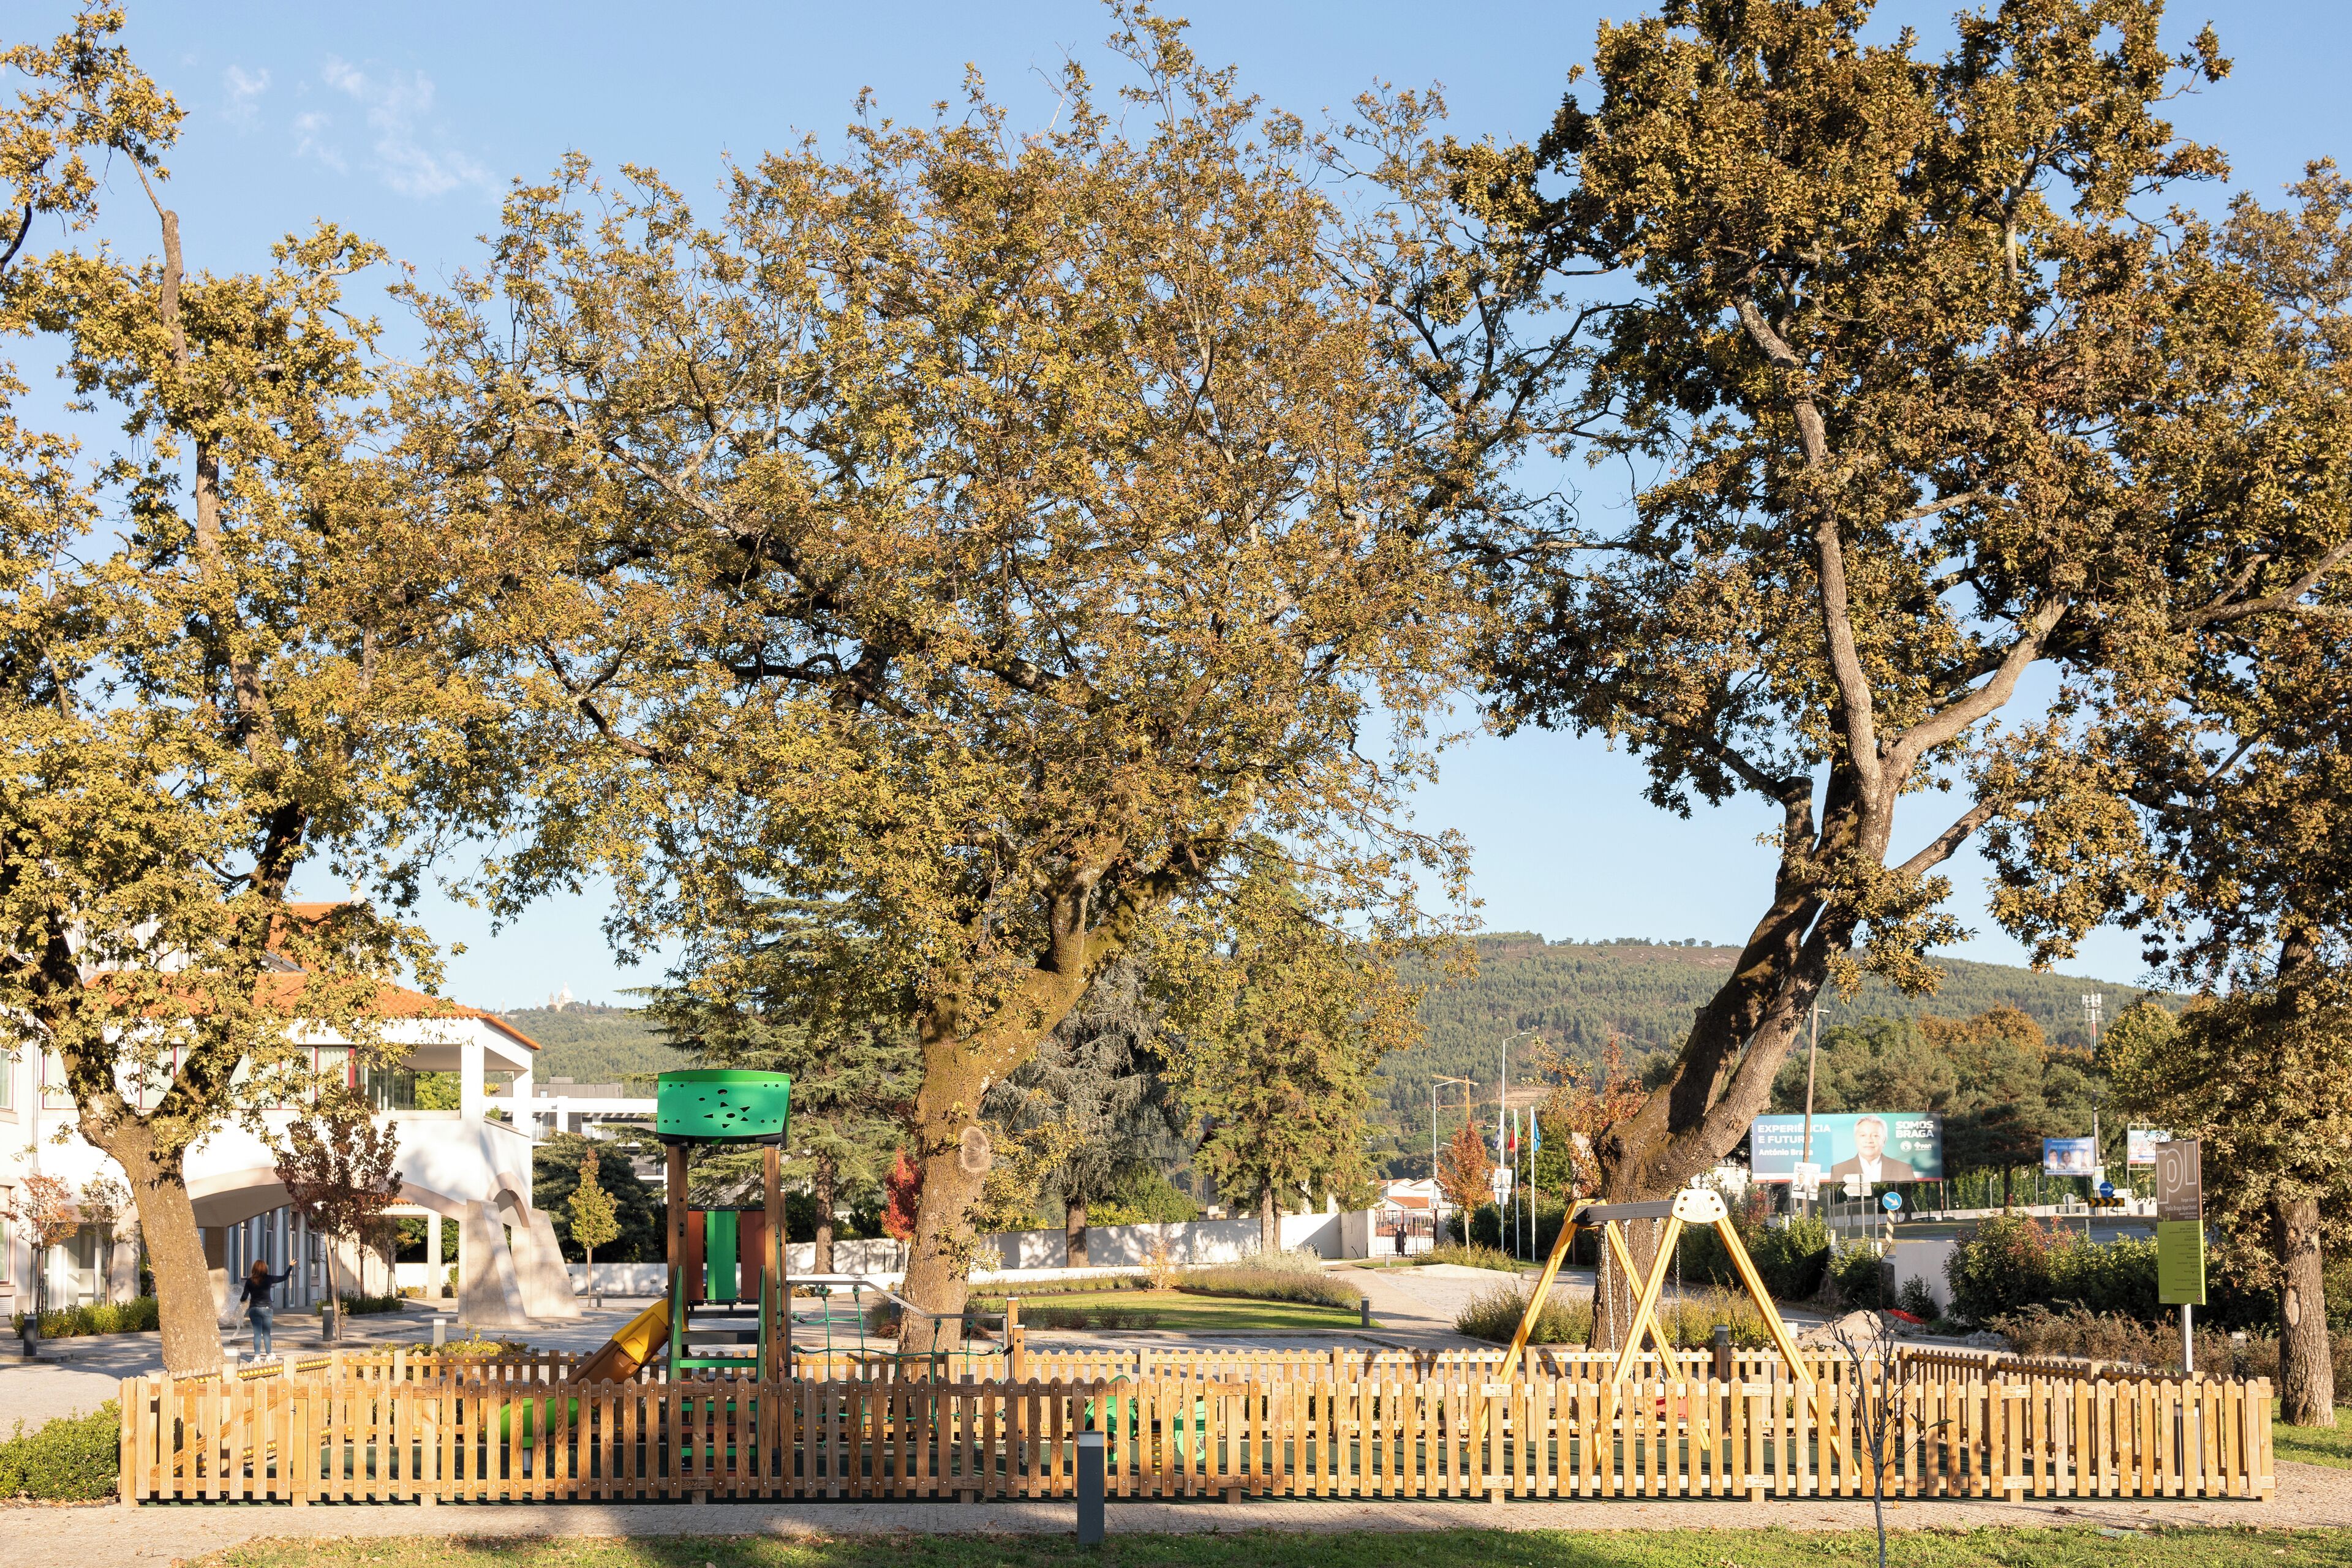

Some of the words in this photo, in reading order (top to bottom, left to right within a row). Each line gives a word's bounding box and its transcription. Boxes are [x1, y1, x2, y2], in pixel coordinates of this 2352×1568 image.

[1758, 1123, 1831, 1133] EXPERIÊCIA
[1895, 1120, 1934, 1129] SOMOS
[1896, 1129, 1934, 1138] BRAGA
